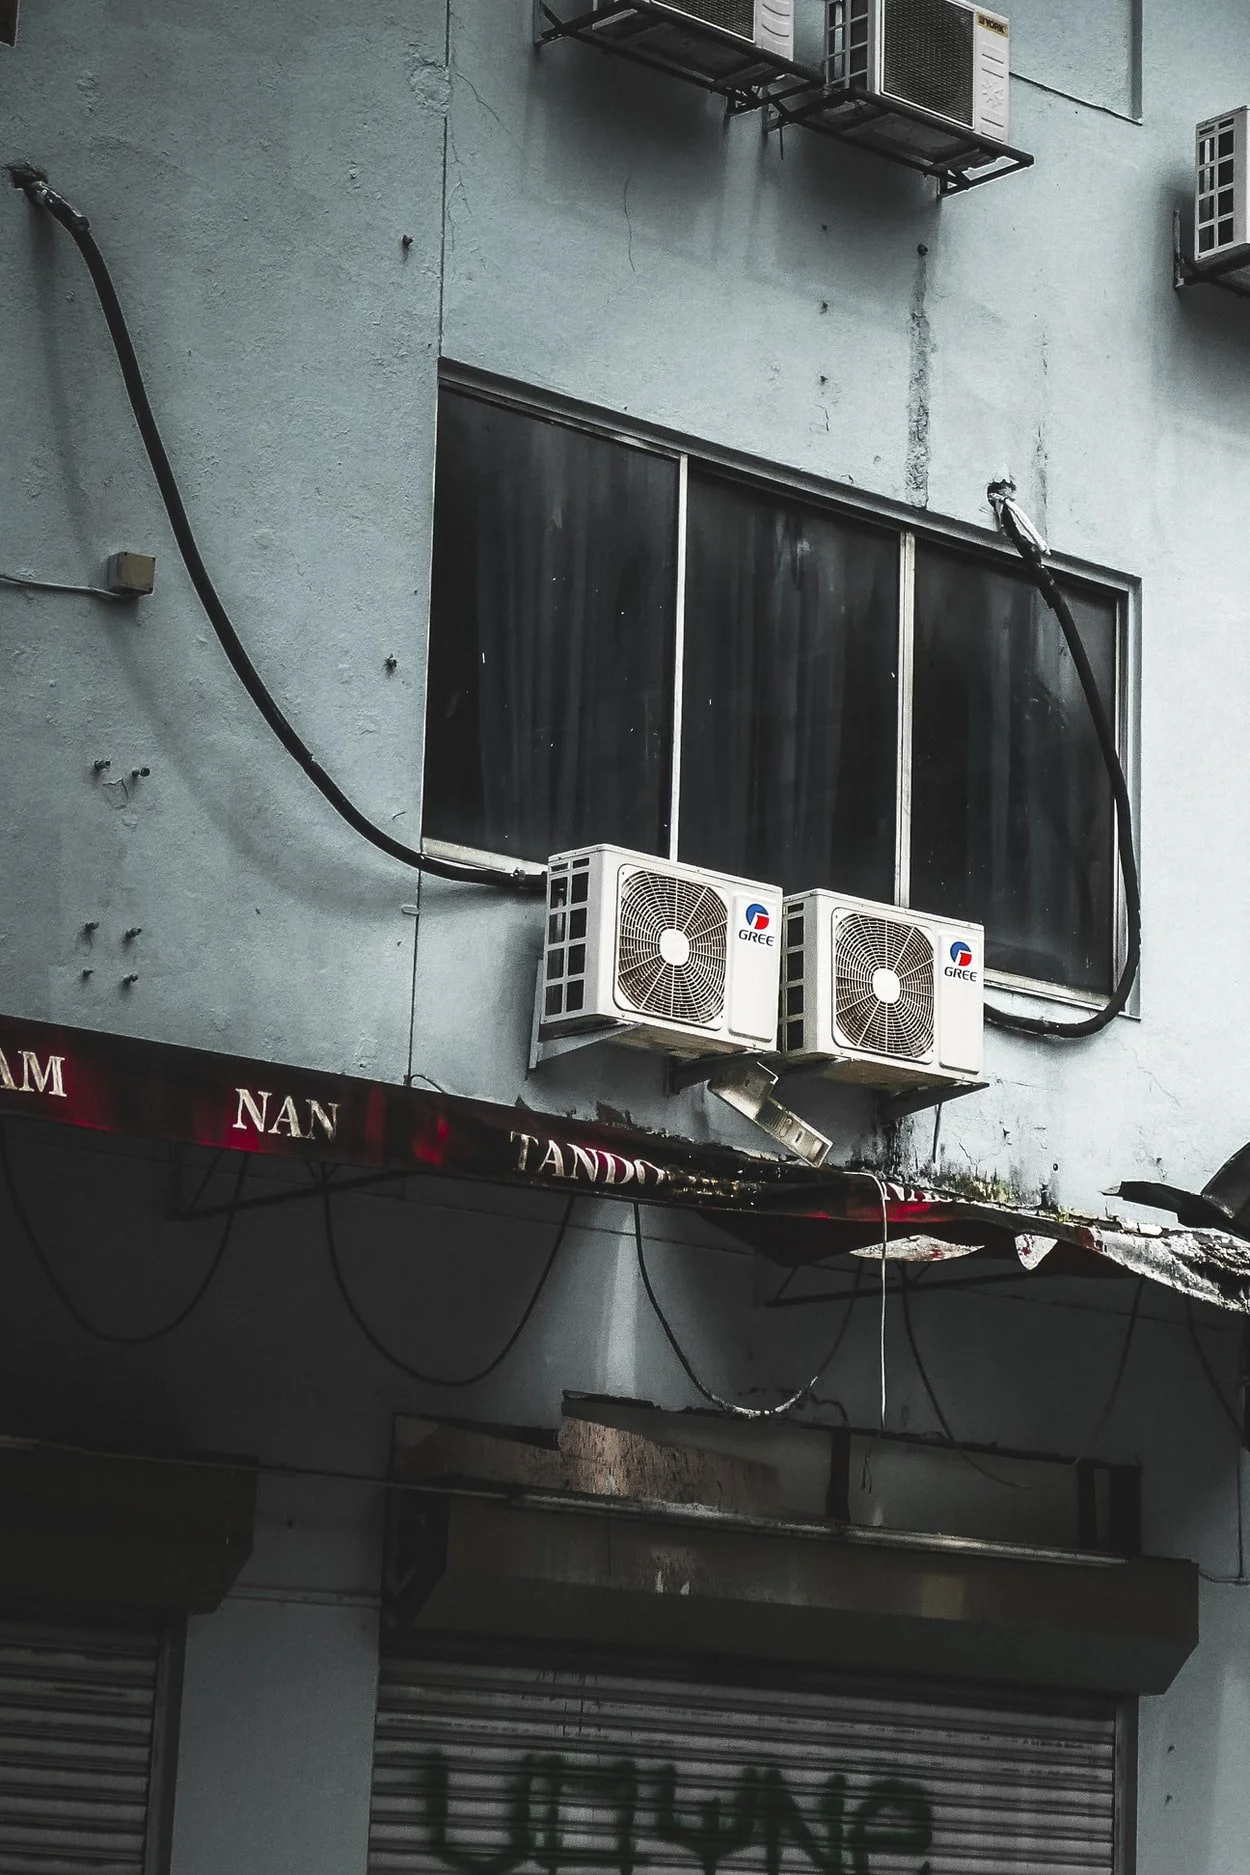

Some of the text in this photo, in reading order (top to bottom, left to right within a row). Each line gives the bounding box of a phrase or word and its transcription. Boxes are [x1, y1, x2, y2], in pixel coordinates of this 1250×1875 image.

[738, 929, 775, 946] GREE
[944, 966, 978, 982] GREE
[232, 1088, 341, 1140] NAN
